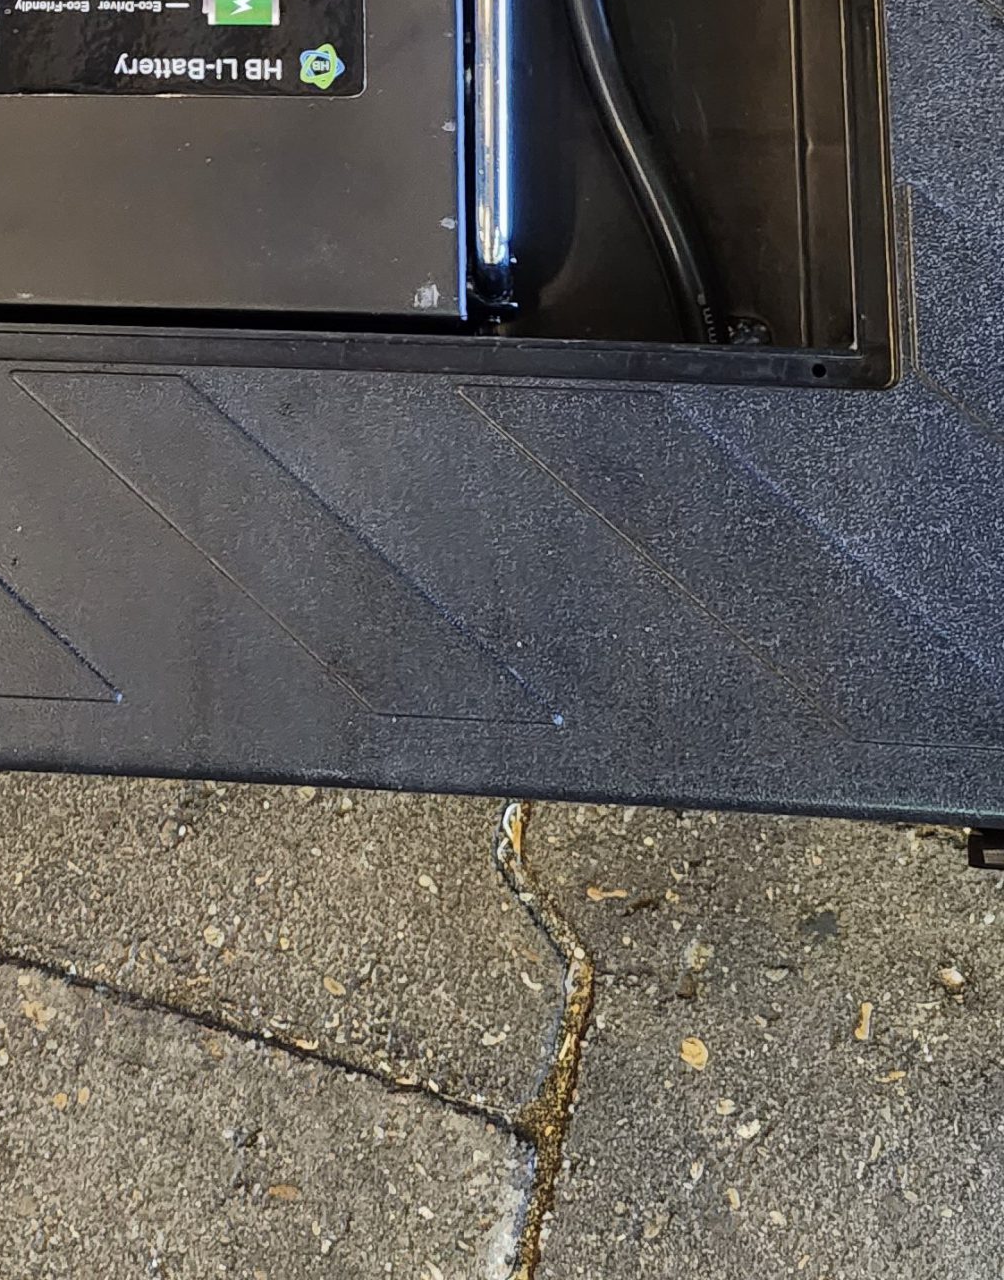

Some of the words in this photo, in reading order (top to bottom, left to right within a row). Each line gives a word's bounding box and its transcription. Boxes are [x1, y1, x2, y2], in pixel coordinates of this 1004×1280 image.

[14, 0, 90, 12] Eco-Friendly
[98, 0, 162, 12] Eco-Driver
[114, 53, 238, 80] Li-Battery
[244, 58, 283, 80] HB
[312, 60, 330, 70] HB
